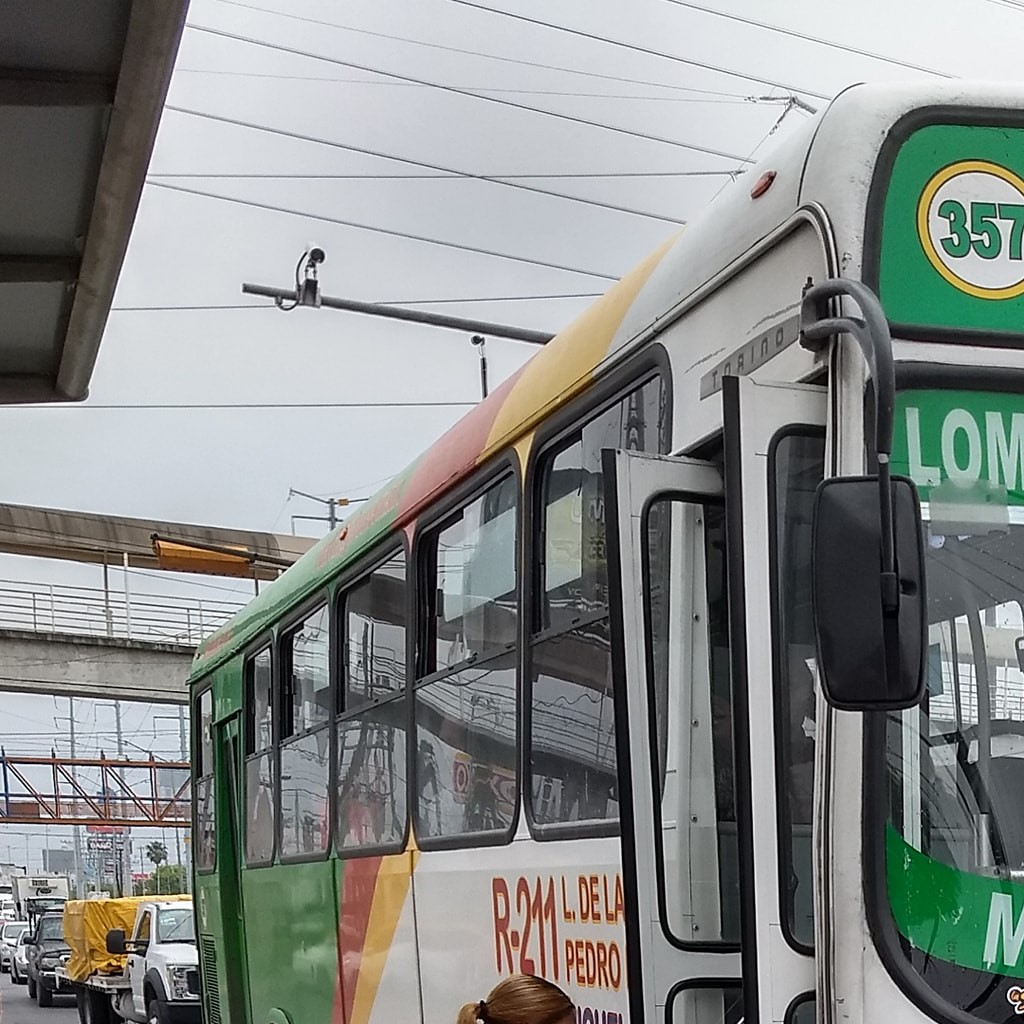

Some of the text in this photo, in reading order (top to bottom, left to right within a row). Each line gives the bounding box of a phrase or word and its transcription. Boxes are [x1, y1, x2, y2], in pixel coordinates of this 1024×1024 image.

[561, 874, 625, 926] L. DE LA
[491, 875, 560, 983] R-211
[565, 939, 622, 991] PEDRO
